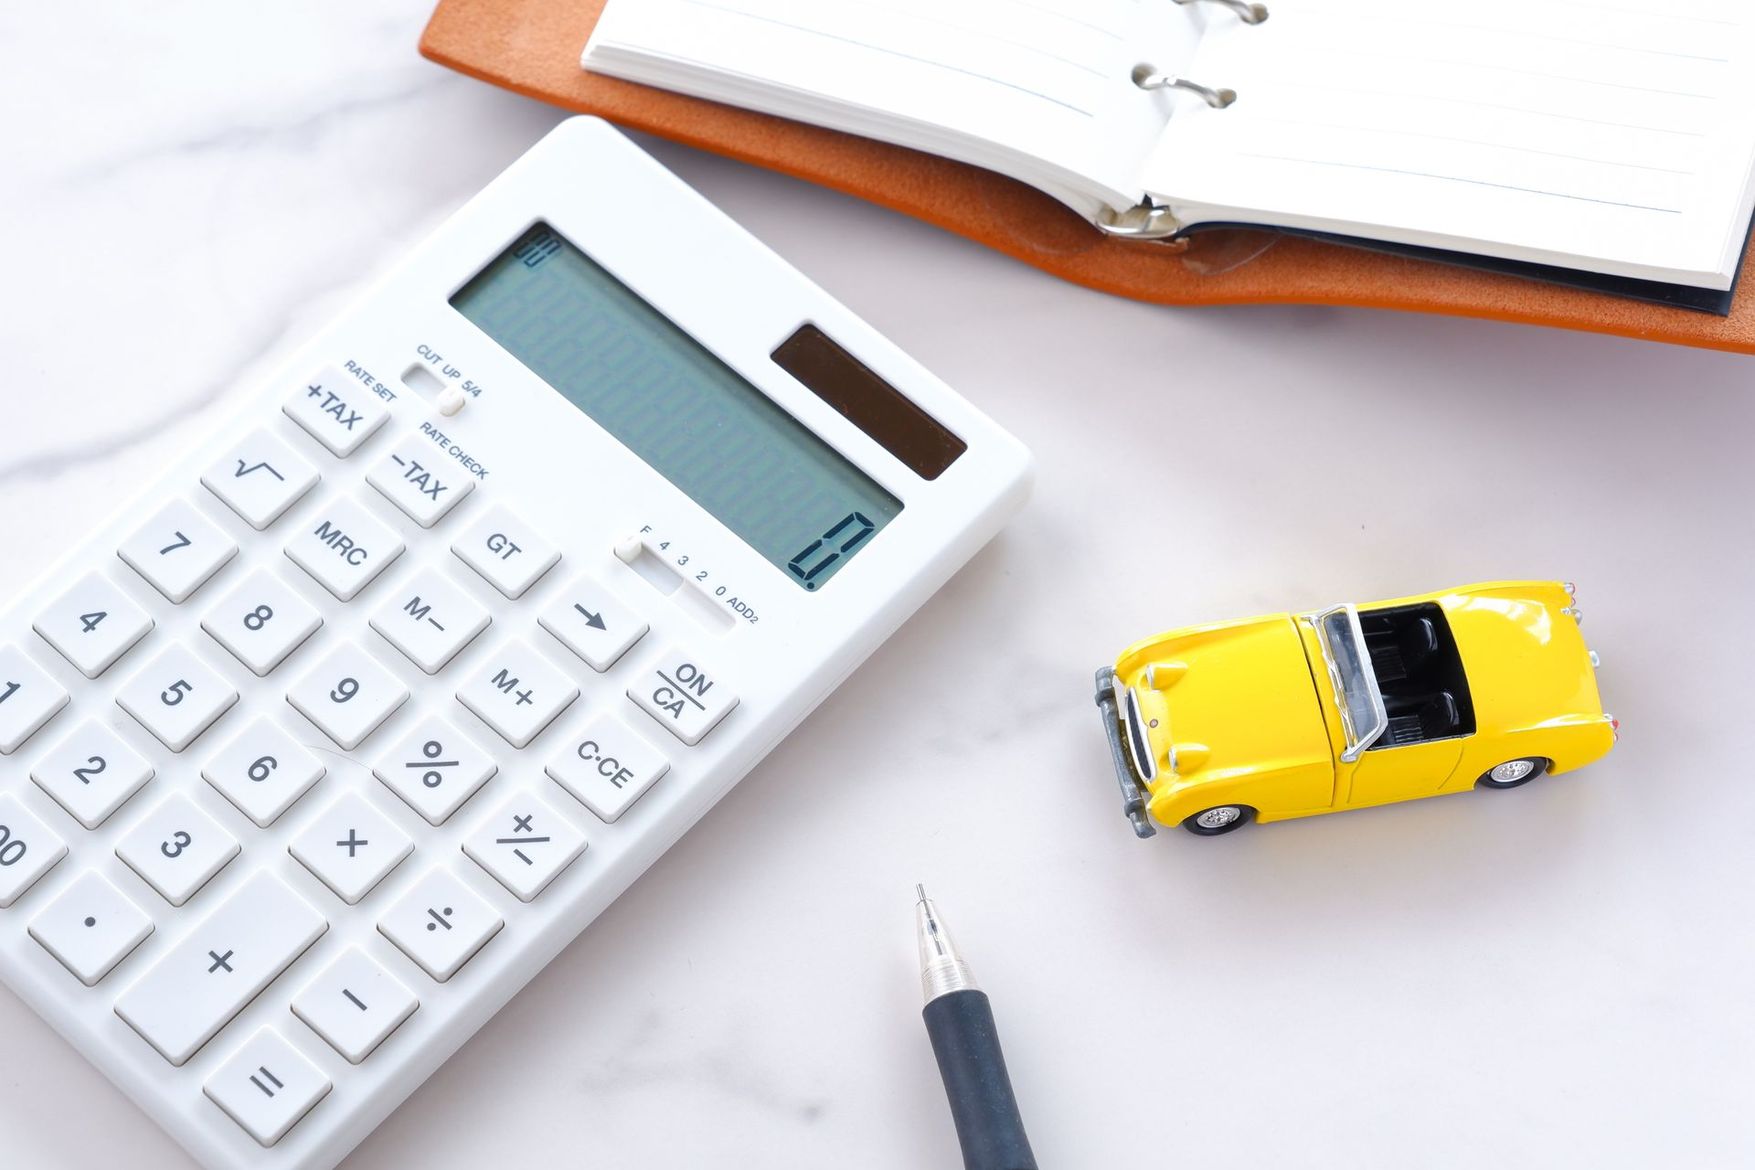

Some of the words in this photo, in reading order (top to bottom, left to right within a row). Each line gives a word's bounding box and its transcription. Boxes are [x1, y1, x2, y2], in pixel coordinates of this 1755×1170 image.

[344, 360, 376, 387] RATE
[371, 380, 398, 403] SET
[416, 344, 443, 366] CUT
[441, 363, 462, 382] UP
[461, 380, 483, 398] 5/4
[307, 384, 364, 431] +TAX
[419, 421, 452, 449] RATE
[447, 444, 490, 481] CHECK
[391, 454, 449, 502] -TAX
[160, 530, 192, 556] 7
[314, 520, 368, 566] MRC
[486, 533, 523, 561] GT
[639, 524, 653, 535] F
[659, 541, 671, 551] 4
[677, 555, 690, 566] 3
[695, 570, 709, 582] 2
[715, 585, 727, 597] 0
[80, 611, 108, 634] 4
[244, 604, 274, 631] 8
[0, 680, 22, 705] 1
[161, 679, 194, 707] 5
[330, 677, 360, 704] 9
[491, 668, 534, 706] M+
[675, 663, 714, 697] ON
[652, 686, 686, 720] CA
[72, 755, 107, 785] 2
[248, 755, 278, 783] 6
[161, 830, 192, 859] 3
